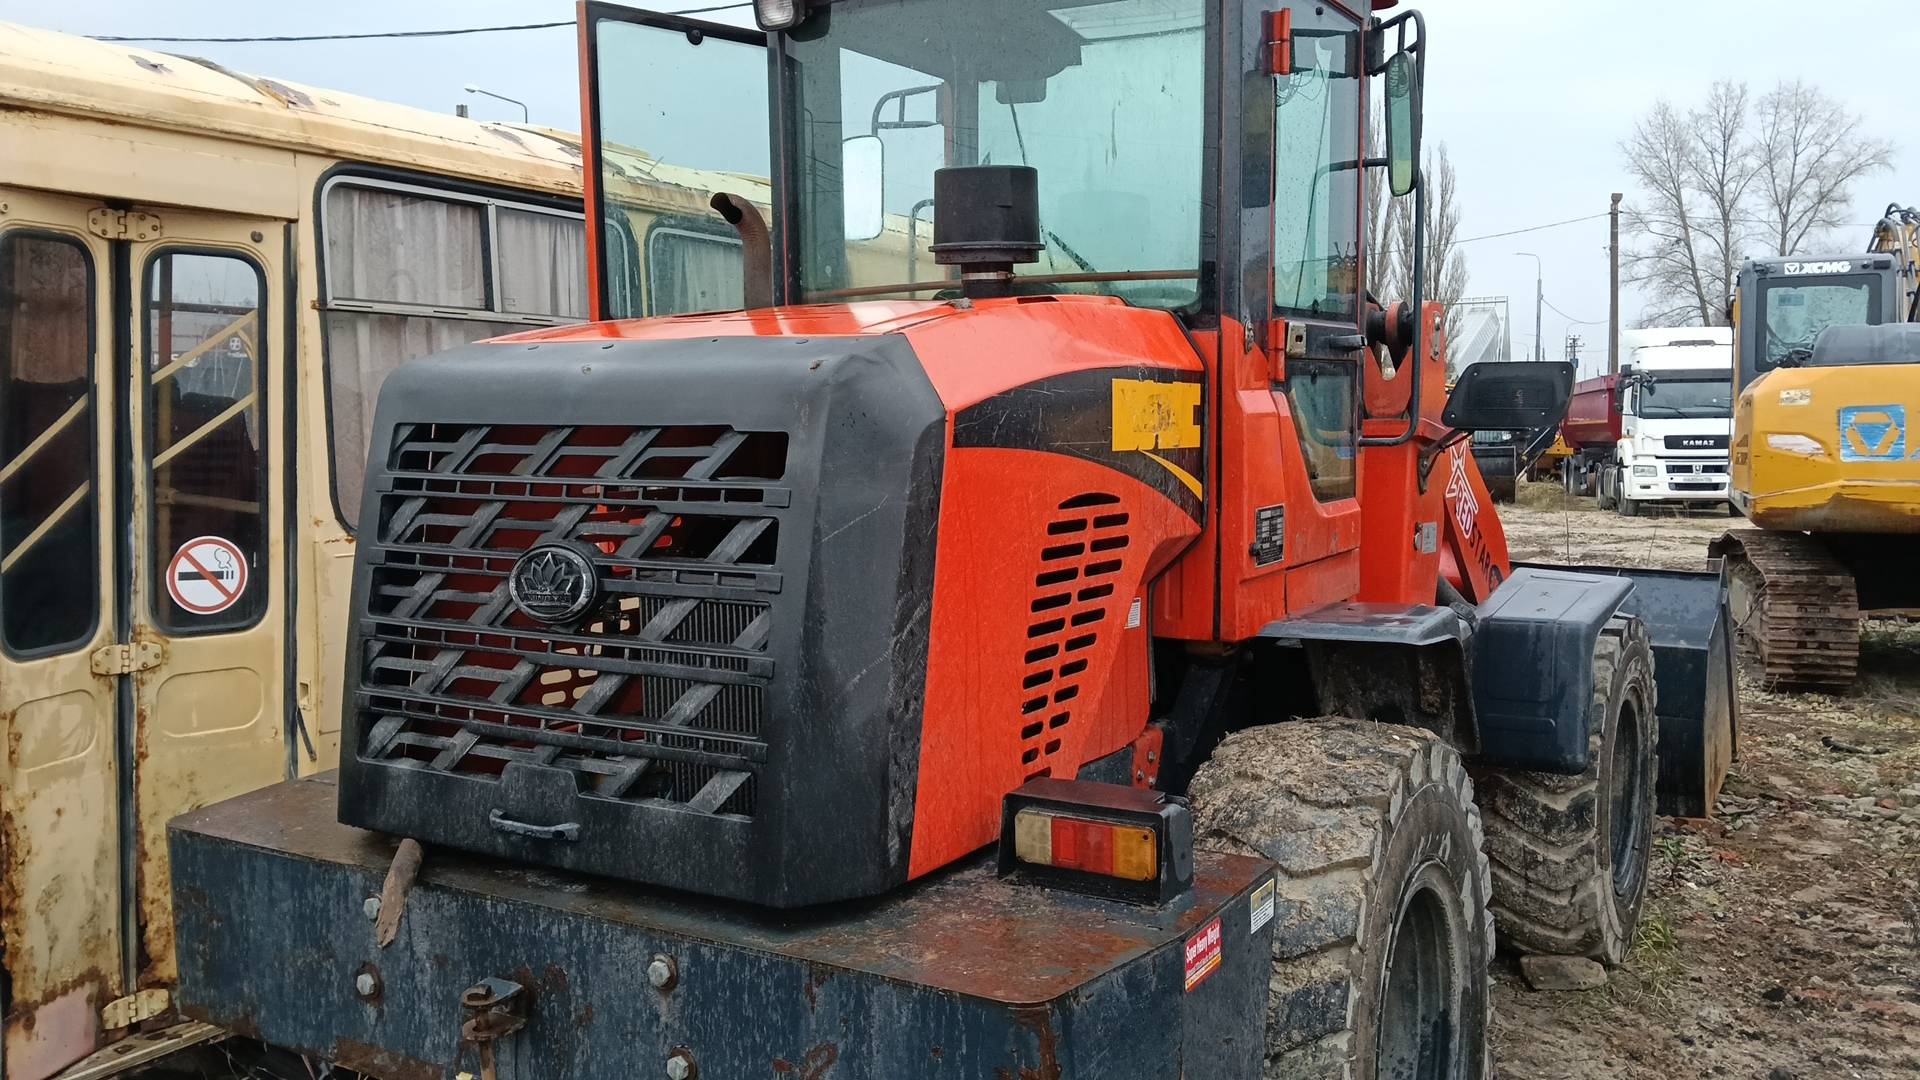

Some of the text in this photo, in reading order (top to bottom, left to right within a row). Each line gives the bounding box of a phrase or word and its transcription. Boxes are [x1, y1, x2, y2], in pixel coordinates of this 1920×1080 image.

[1800, 261, 1852, 274] XCMG
[1456, 484, 1491, 577] RED STAR
